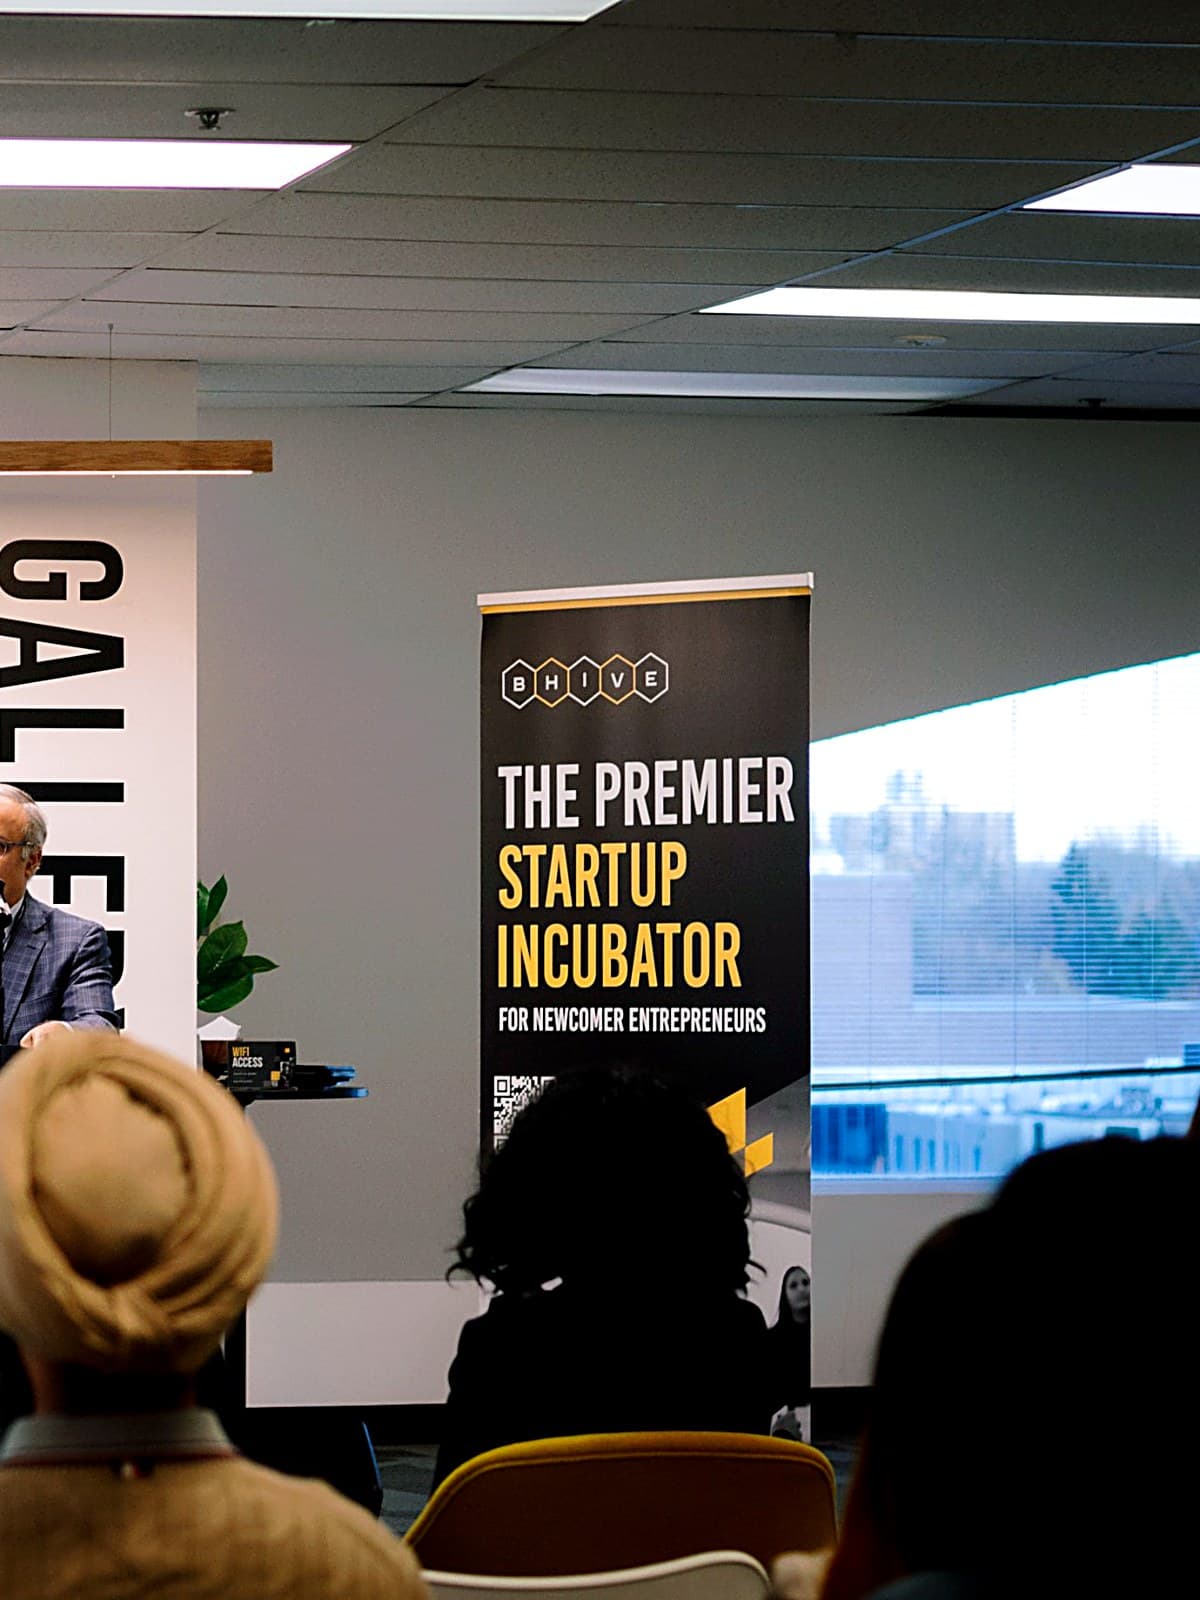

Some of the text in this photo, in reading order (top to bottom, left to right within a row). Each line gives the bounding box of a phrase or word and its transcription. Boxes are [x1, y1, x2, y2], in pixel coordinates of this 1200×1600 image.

[512, 671, 658, 692] BHIVE
[498, 757, 795, 829] THE PREMIER
[498, 841, 688, 909] STARTUP
[497, 922, 742, 989] INCUBATOR
[499, 1007, 767, 1033] FOR NEWCOMER ENTREPRENEURS
[232, 1047, 250, 1057] WIFI
[232, 1056, 263, 1068] ACCESS
